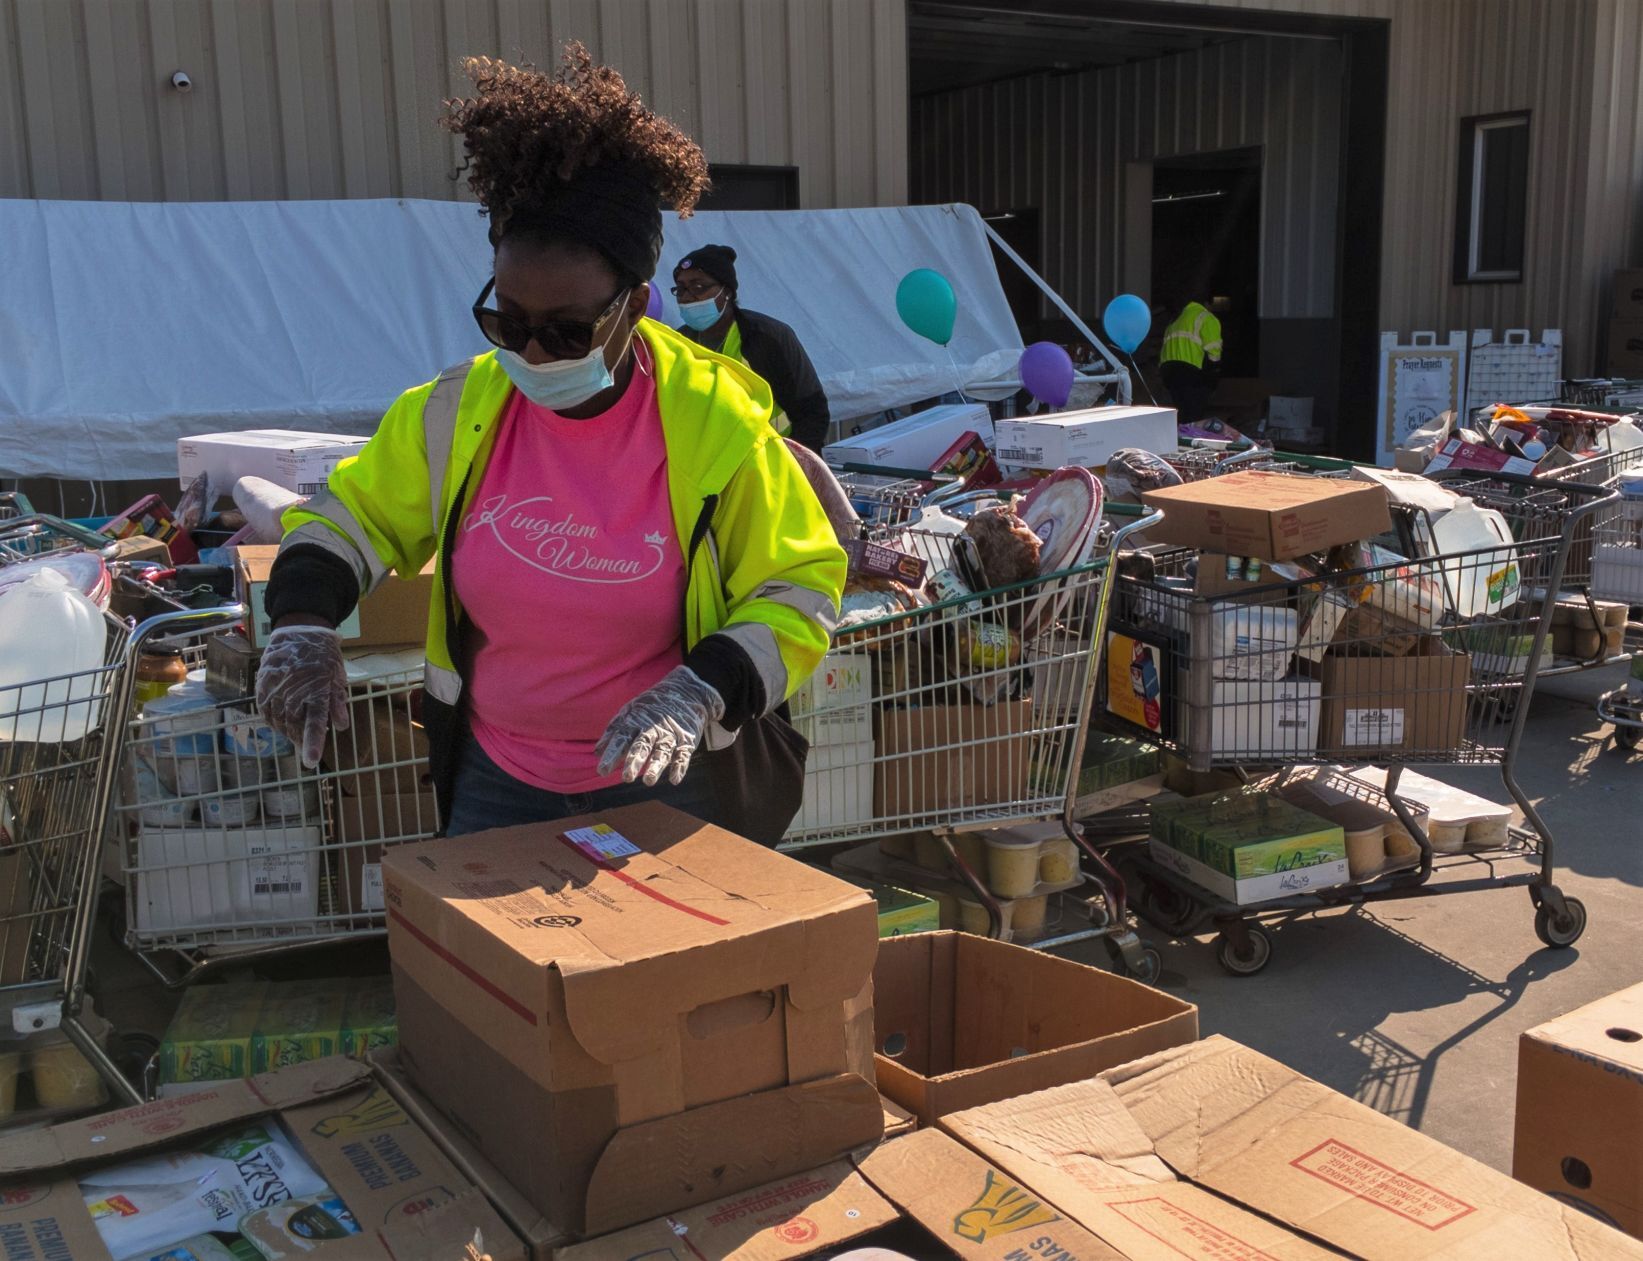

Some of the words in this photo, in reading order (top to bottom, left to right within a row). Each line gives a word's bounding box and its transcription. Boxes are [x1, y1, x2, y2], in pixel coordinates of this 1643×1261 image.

[464, 494, 598, 540] Kingdom
[537, 537, 641, 575] Woman
[865, 551, 898, 565] BAKERY
[369, 1133, 421, 1182] BANANAS
[1326, 1146, 1354, 1163] SALES
[341, 1142, 393, 1190] PREMIUM
[1354, 1159, 1377, 1171] AND
[1317, 1164, 1355, 1189] MARKED
[783, 1182, 831, 1203] HANDLE
[1414, 1186, 1428, 1195] TO
[754, 1198, 779, 1212] WITH
[1429, 1194, 1460, 1213] PRIOR
